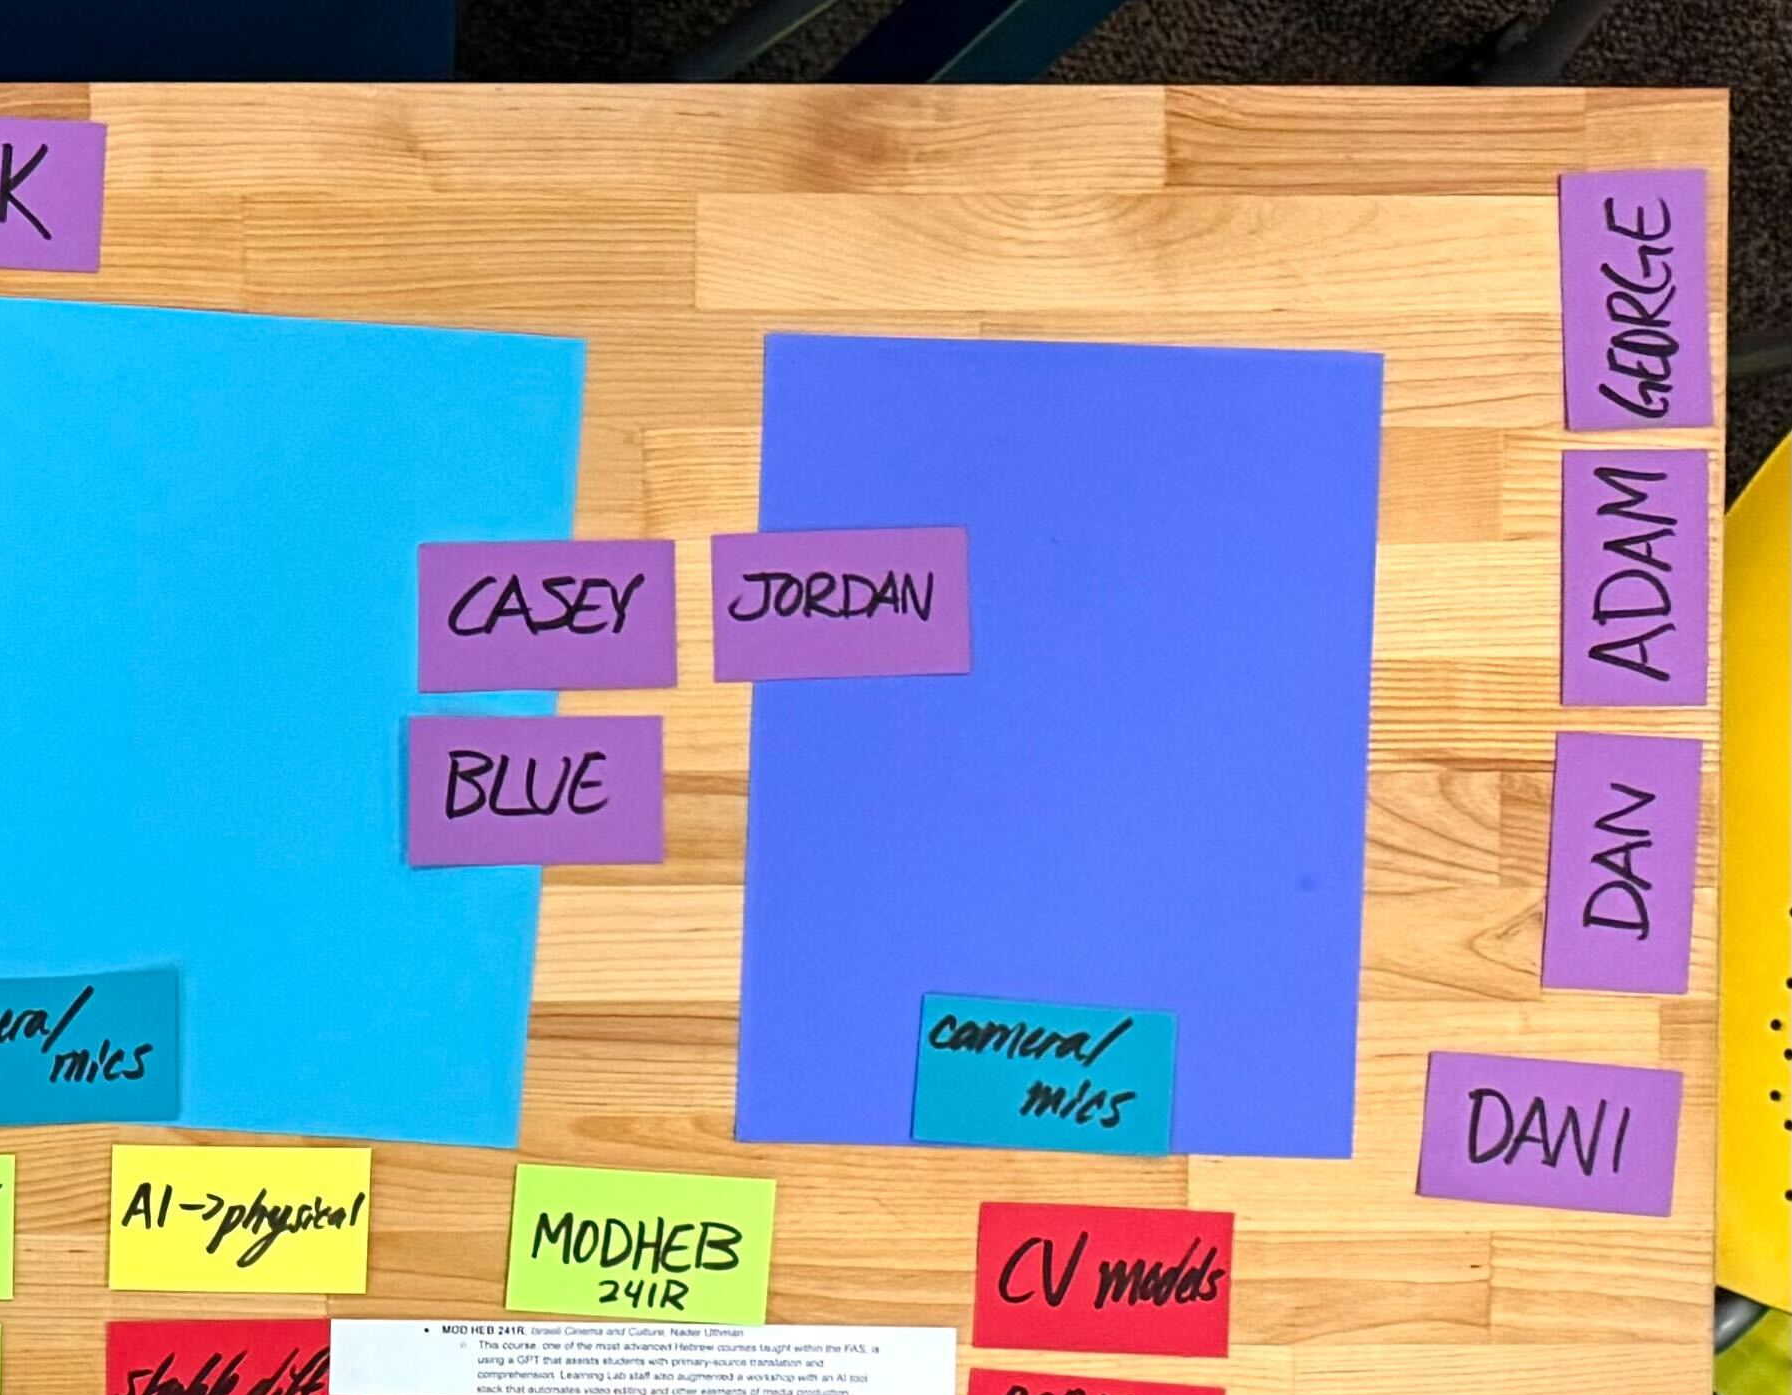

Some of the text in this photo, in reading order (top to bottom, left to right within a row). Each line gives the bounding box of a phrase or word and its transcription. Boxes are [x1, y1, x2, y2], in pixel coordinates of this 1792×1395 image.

[1599, 198, 1679, 418] GEORGE
[449, 574, 644, 635] CASEY
[729, 571, 933, 621] JORDAN
[1589, 468, 1672, 681] ADAM
[446, 751, 607, 819] BLUE
[1583, 784, 1655, 940] DAN
[50, 1039, 153, 1084] mics
[1019, 1079, 1136, 1129] mics
[1469, 1089, 1629, 1175] DANI
[600, 1280, 688, 1310] 241R
[999, 1236, 1224, 1309] CV models
